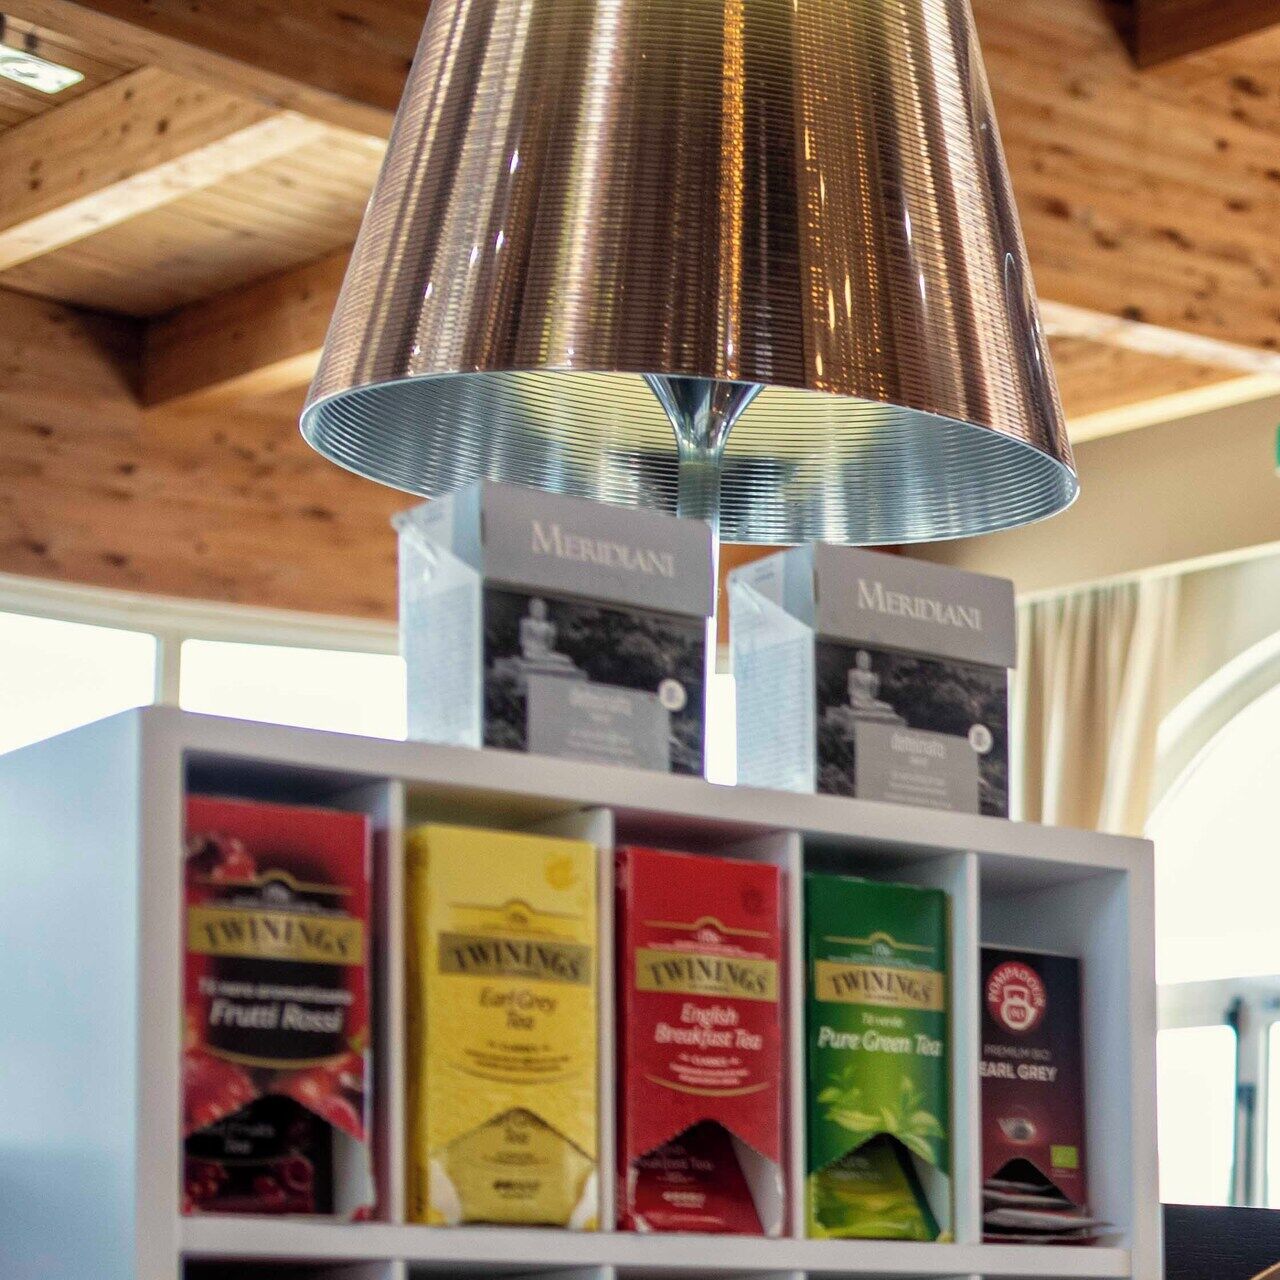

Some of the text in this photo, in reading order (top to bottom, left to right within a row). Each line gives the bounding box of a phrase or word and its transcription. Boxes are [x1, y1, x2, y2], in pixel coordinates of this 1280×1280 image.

[529, 519, 676, 580] MERIDIANI
[857, 578, 982, 631] MERIDIANI
[203, 917, 353, 957] TWININGS
[455, 941, 584, 980] TWININGS
[649, 957, 768, 994] TWININGS
[830, 970, 932, 1003] TWININGS
[209, 998, 279, 1029] Frutti
[680, 1002, 740, 1029] English
[654, 1022, 764, 1050] Breakfast Tea
[817, 1025, 941, 1057] Pure Green Tea
[979, 1060, 1058, 1082] EARL GREY
